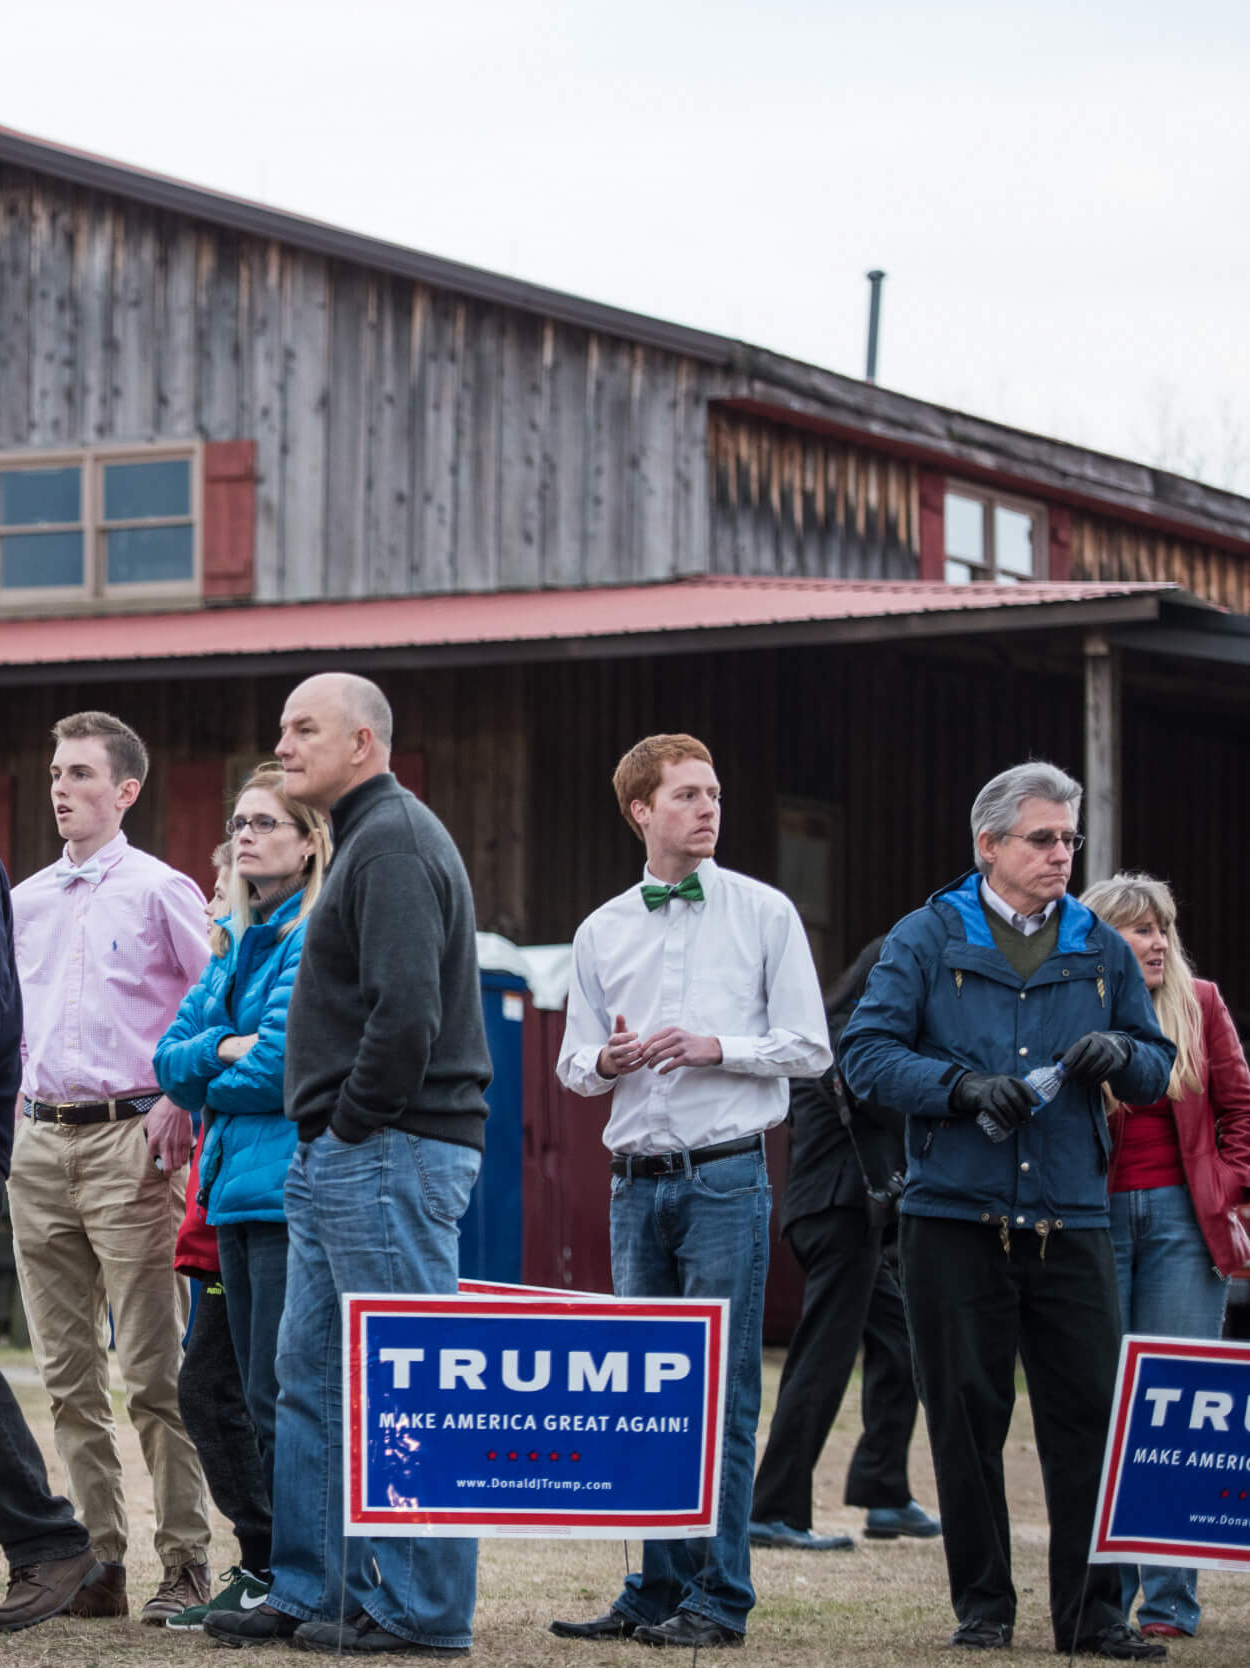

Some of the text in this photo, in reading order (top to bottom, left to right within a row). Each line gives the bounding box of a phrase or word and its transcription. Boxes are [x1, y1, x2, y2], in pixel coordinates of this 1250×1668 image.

[379, 1348, 691, 1393] TRUMP
[378, 1412, 689, 1433] MAKE AMERICA GREAT AGAIN!
[1133, 1448, 1182, 1466] MAKE
[456, 1477, 612, 1492] www.DonaldJTrump.com
